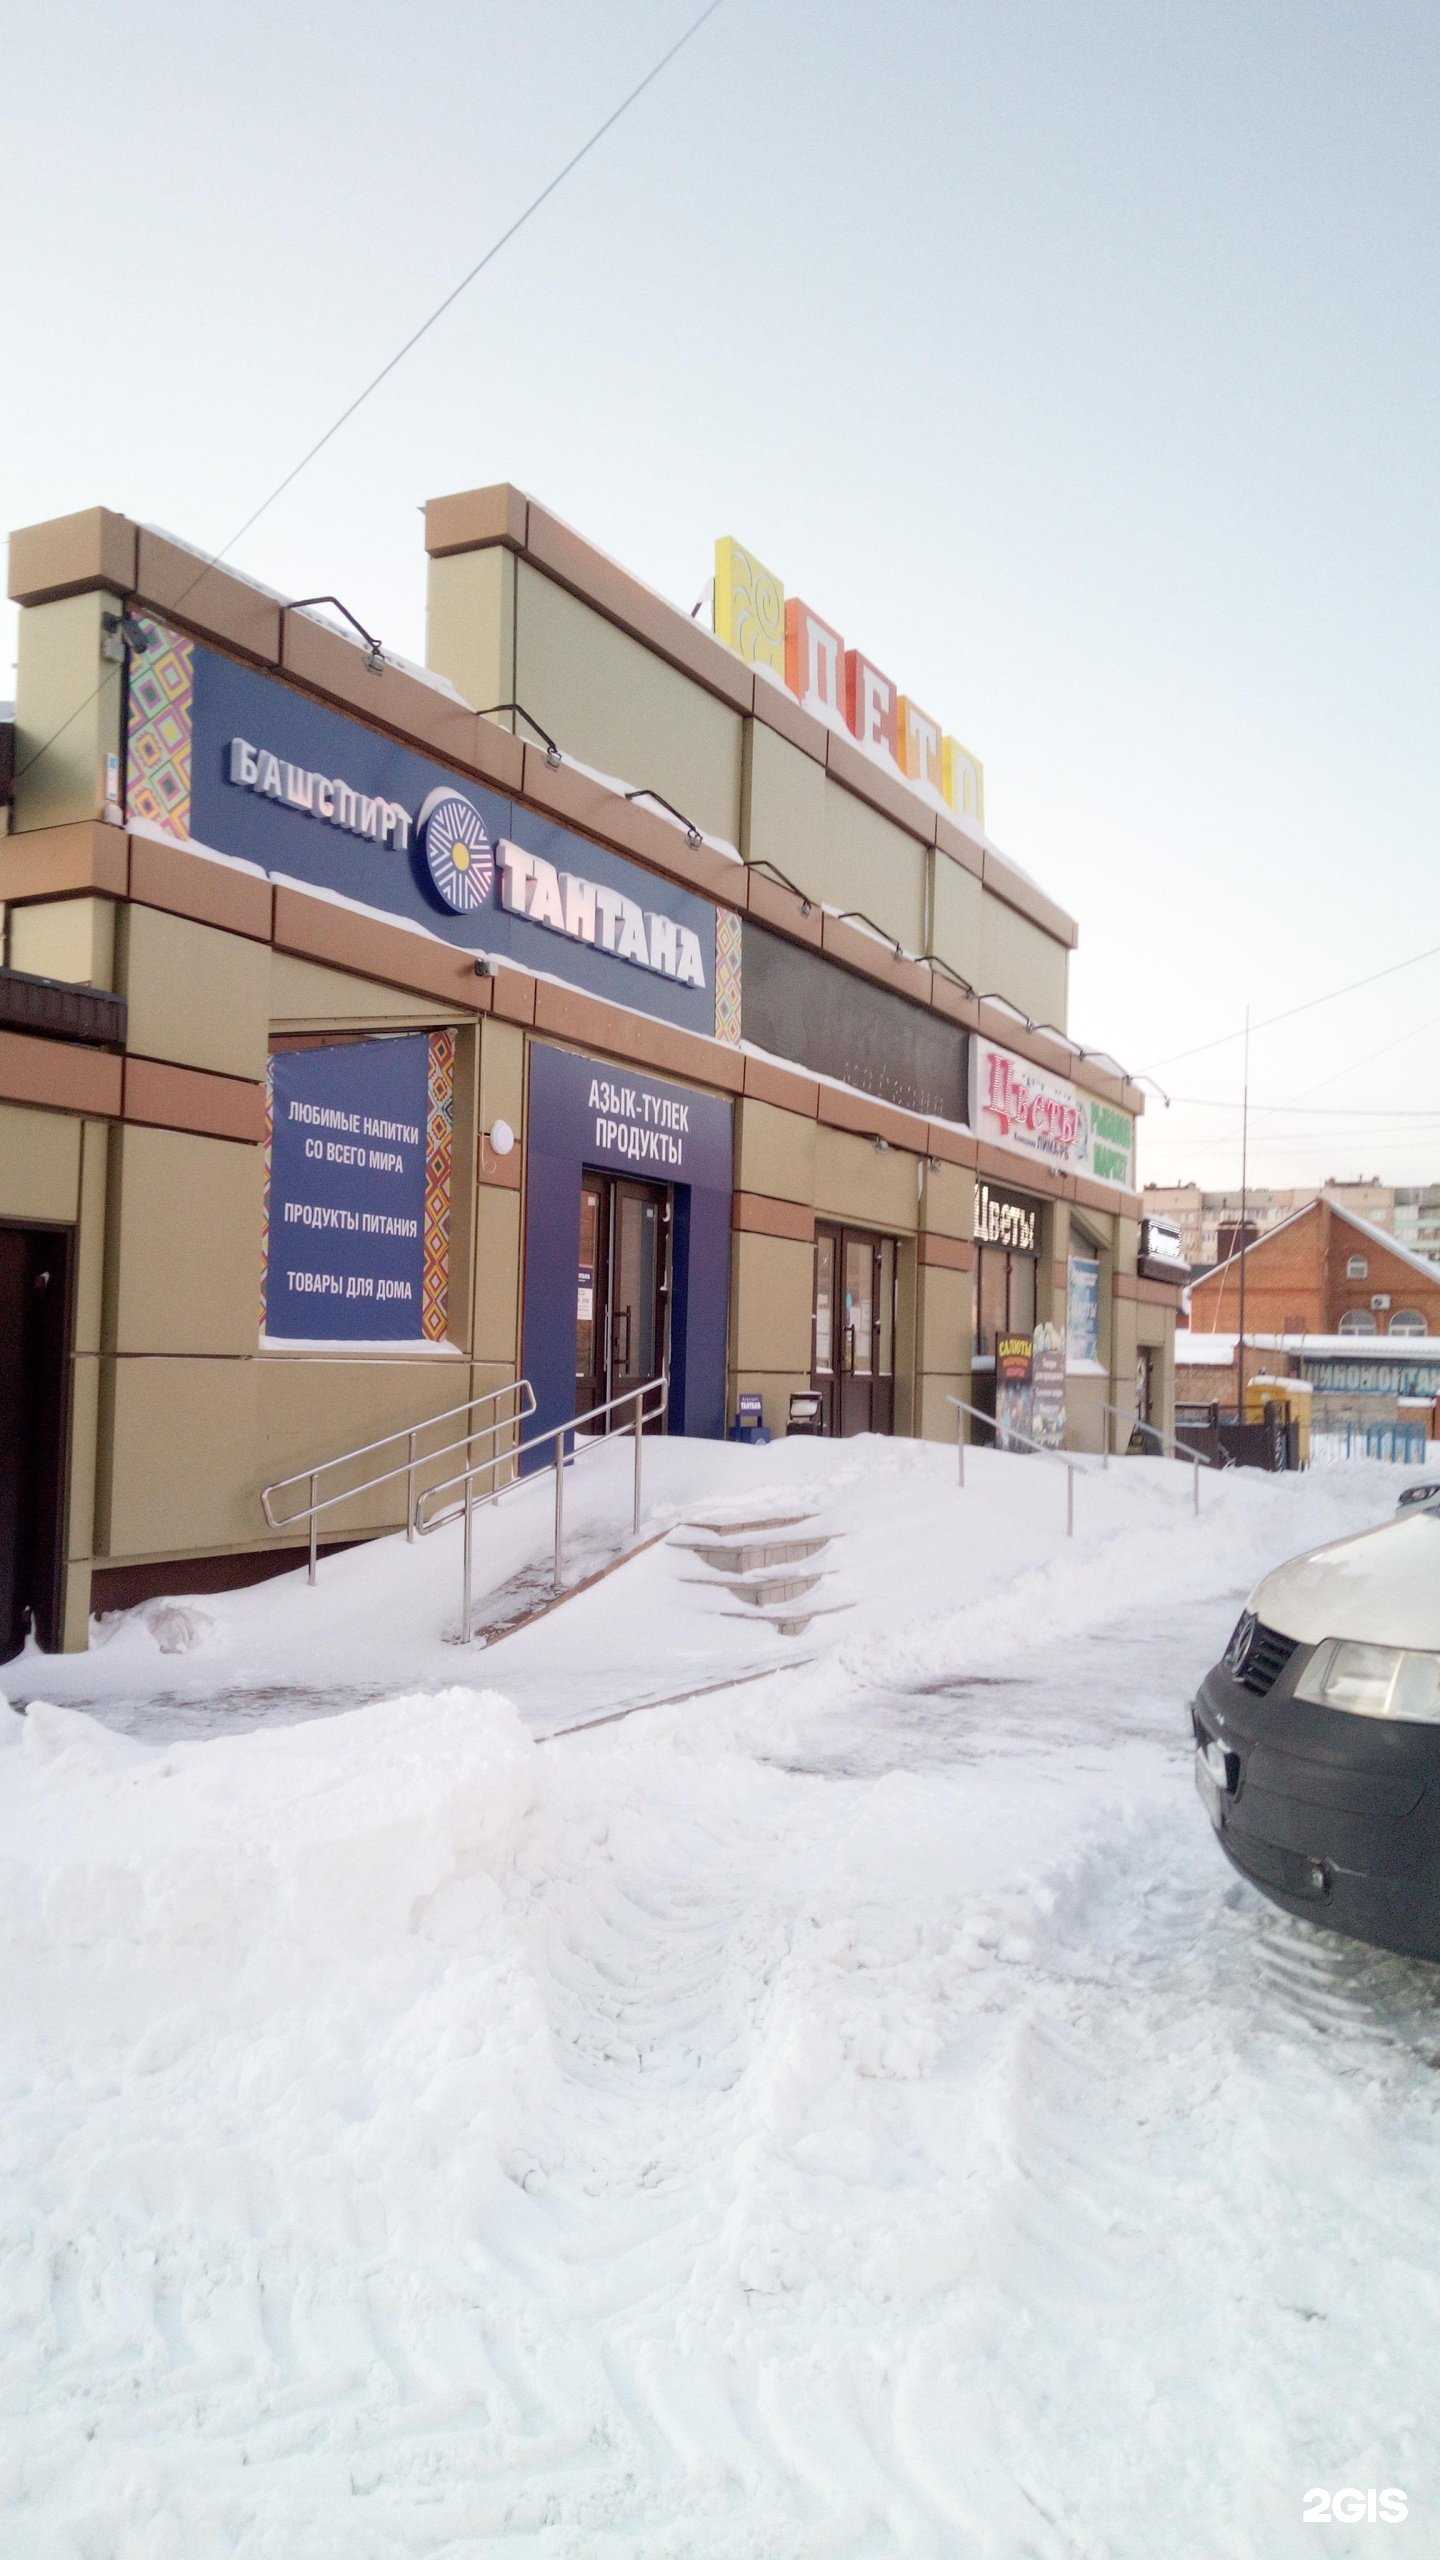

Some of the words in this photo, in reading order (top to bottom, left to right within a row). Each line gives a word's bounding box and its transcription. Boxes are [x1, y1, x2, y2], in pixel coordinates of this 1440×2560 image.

[231, 737, 413, 850] БАШСПИРТ
[496, 838, 706, 988] ТАНТАНА
[288, 1100, 361, 1134] ЛЮБИМЫЕ
[363, 1116, 419, 1146] НАПИТКИ
[595, 1117, 683, 1166] ПРОДУКТЫ
[304, 1138, 323, 1160] СО
[326, 1142, 366, 1168] ВСЕГО
[369, 1150, 404, 1174] МИРА
[284, 1202, 360, 1230] ПРОДУКТЫ
[362, 1213, 417, 1238] ПИТАНИЯ
[287, 1271, 343, 1295] ТОВАРЫ
[346, 1276, 373, 1299] ДЛЯ
[376, 1279, 412, 1301] ДОМА
